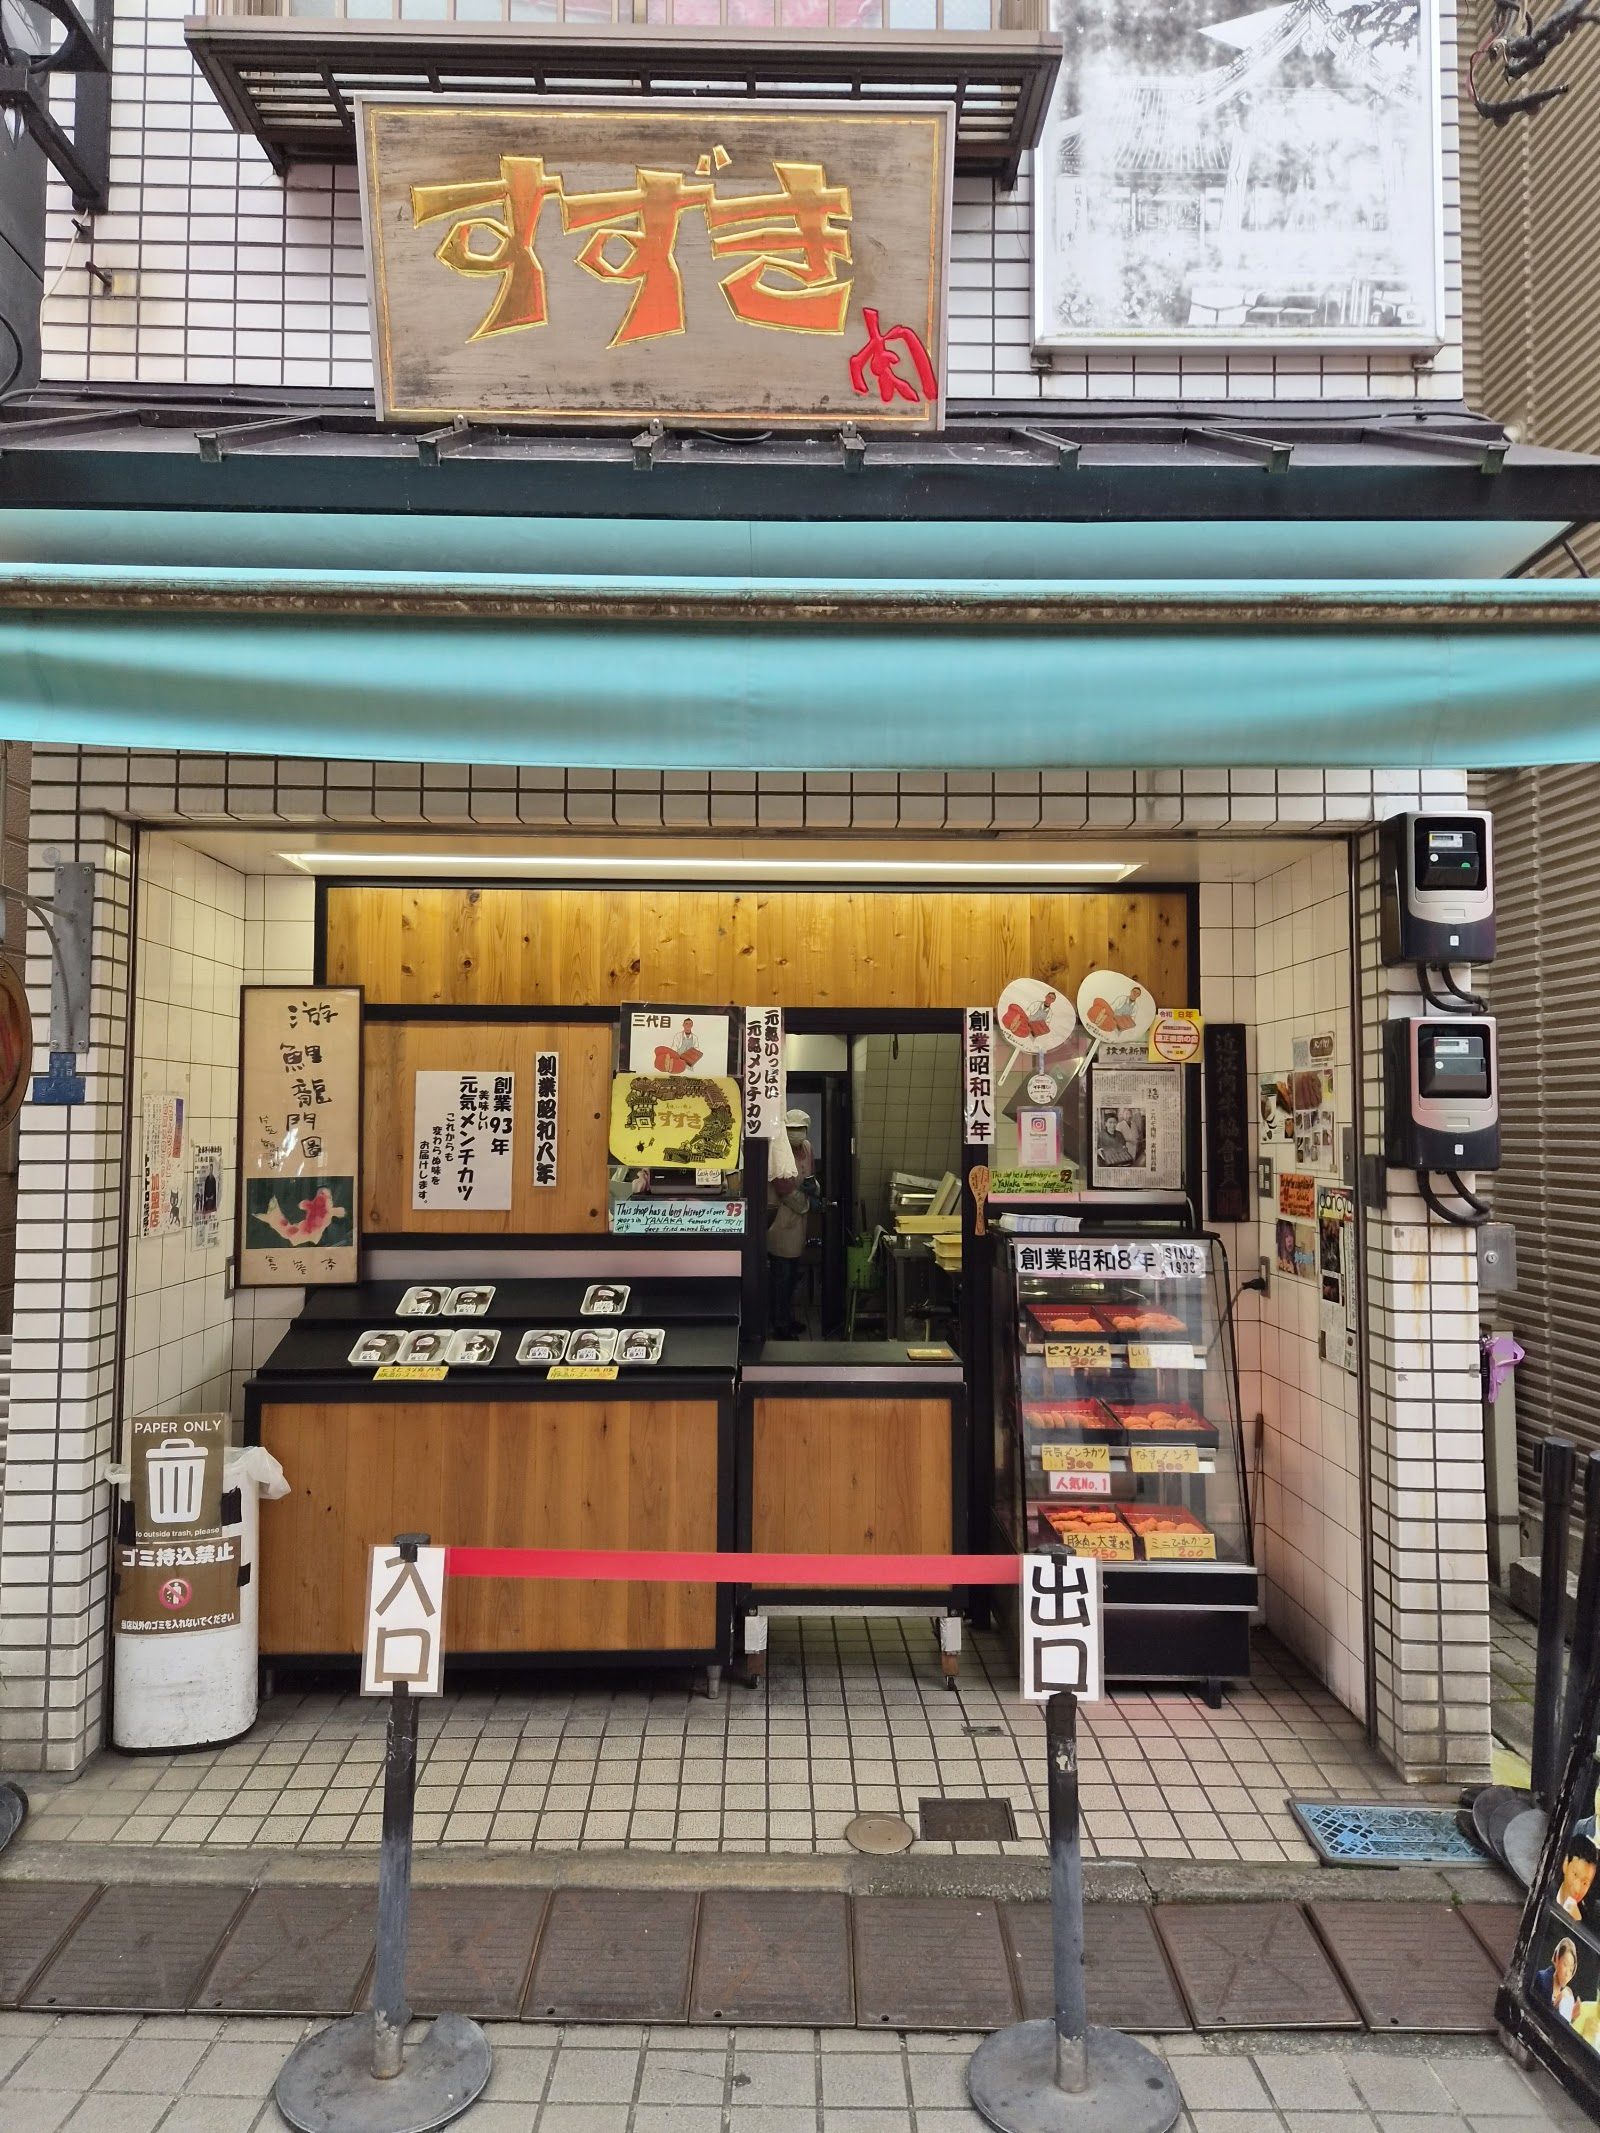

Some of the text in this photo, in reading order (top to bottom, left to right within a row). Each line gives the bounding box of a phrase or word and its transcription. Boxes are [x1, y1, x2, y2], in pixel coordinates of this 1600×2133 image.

[409, 144, 855, 348] すずき
[632, 1014, 672, 1029] 三代目
[969, 1010, 991, 1142] 創業昭和八年
[478, 1089, 489, 1130] 美味しい
[536, 1054, 557, 1185] 創業昭和八年
[431, 1126, 443, 1186] 変わらぬ味を
[445, 1112, 455, 1162] これからも
[457, 1076, 478, 1201] 元気メンチカツ
[418, 1140, 432, 1205] お届けします。
[616, 1203, 632, 1216] This
[633, 1204, 648, 1217] shop
[648, 1204, 661, 1216] has
[725, 1202, 743, 1217] 93
[1019, 1246, 1157, 1273] 創業昭和8年
[134, 1419, 222, 1434] PAPER ONLY
[1067, 1458, 1094, 1470] 300
[143, 1530, 171, 1539] outside
[172, 1529, 193, 1538] trash,
[194, 1527, 220, 1537] please
[1178, 1548, 1204, 1558] 200
[121, 1542, 235, 1567] ゴミ持込禁止
[121, 1612, 235, 1631] 当店以外のゴミを入れないでください
[374, 1556, 437, 1684] 入口
[1029, 1556, 1092, 1693] 出口
